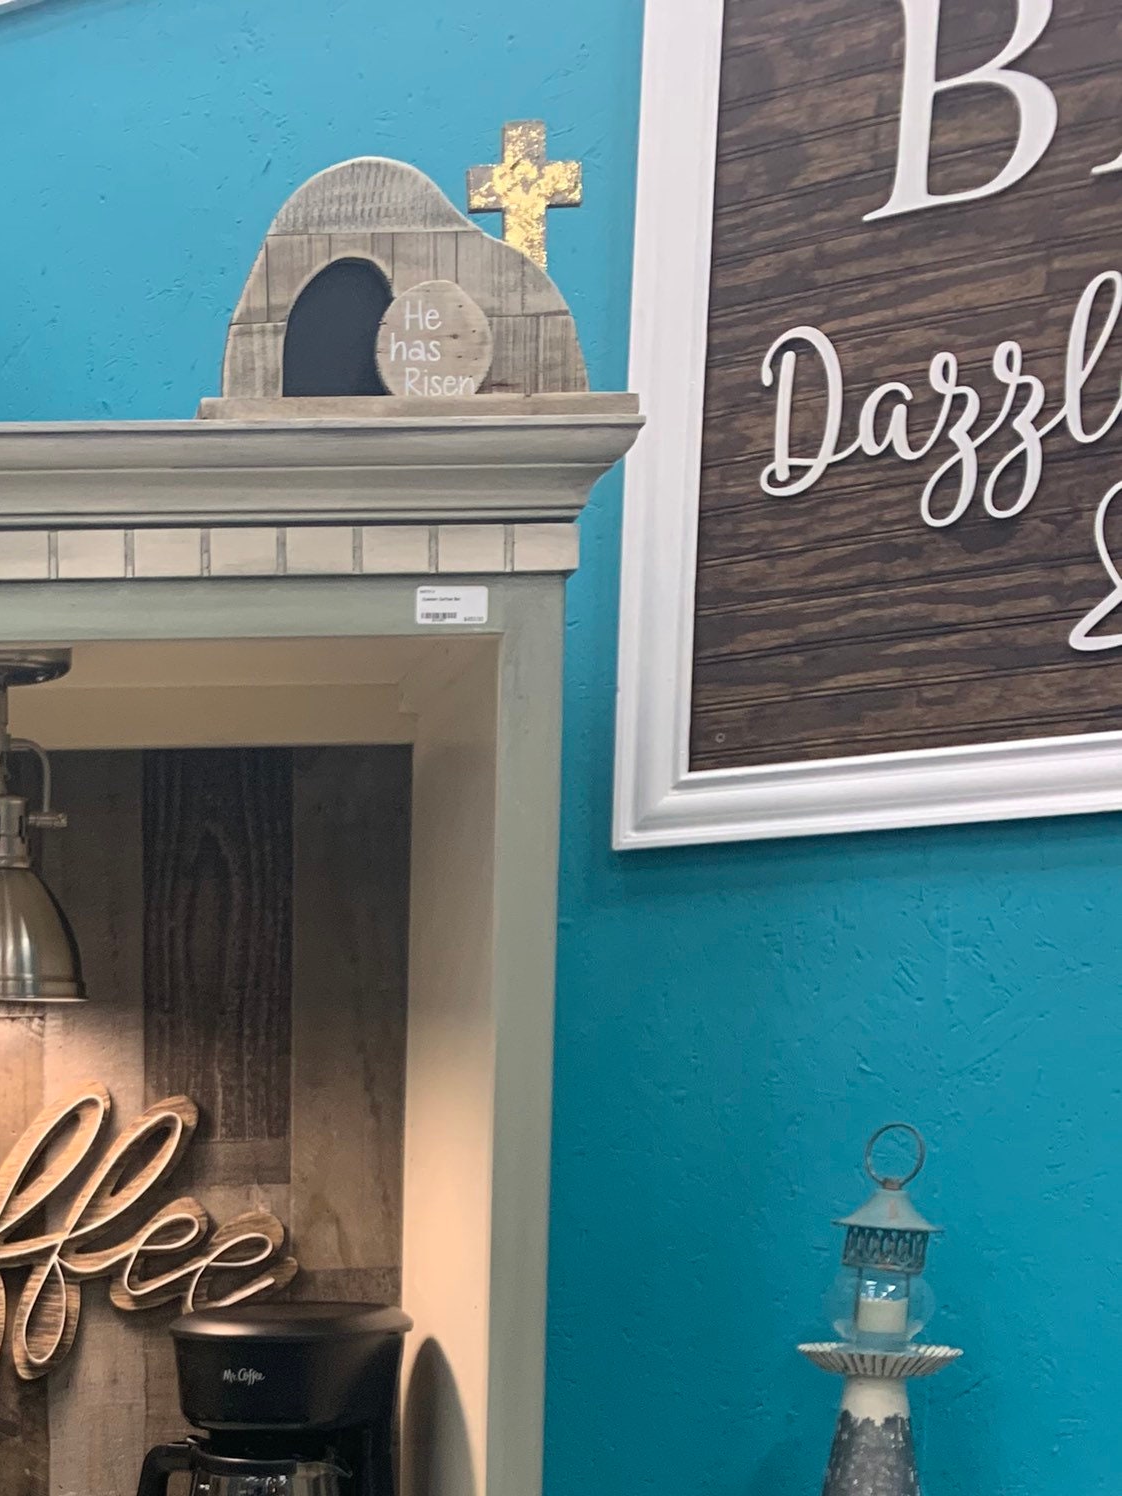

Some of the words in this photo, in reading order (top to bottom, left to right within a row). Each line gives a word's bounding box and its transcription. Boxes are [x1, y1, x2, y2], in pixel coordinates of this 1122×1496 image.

[403, 299, 443, 331] He
[390, 331, 442, 362] has
[404, 366, 476, 397] Risen
[238, 1367, 266, 1386] Coffee
